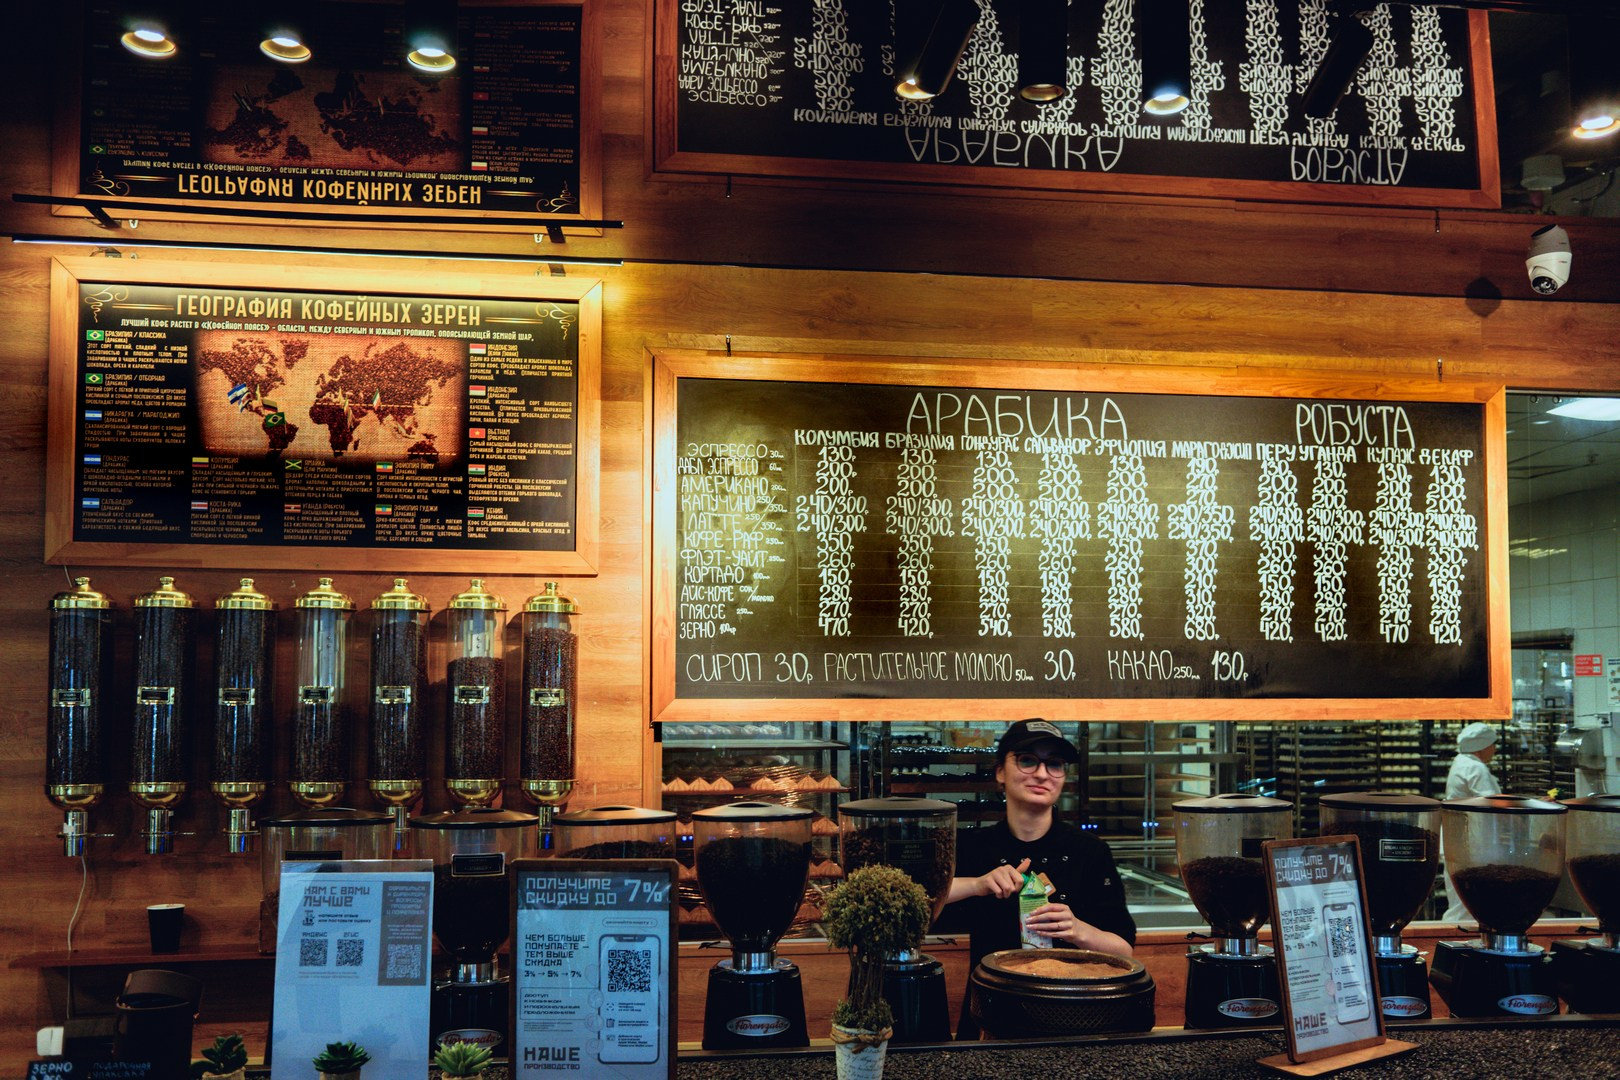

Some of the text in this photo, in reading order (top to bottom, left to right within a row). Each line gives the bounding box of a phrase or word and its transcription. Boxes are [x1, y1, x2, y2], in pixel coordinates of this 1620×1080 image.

[176, 294, 480, 326] ГЕОГРАФИЯ КОФЕЙНЫХ ЗЕРЕН
[121, 318, 149, 328] ЛУЧШИЙ
[151, 319, 169, 328] КОФЕ
[170, 320, 193, 329] РАСТЕТ
[194, 321, 199, 329] В
[309, 325, 332, 334] МЕЖДУ
[334, 326, 367, 335] СЕВЕРНЫМ
[376, 328, 401, 336] ЮЖНЫМ
[438, 330, 490, 340] ОПОЯСЫВАЮЩЕЙ
[492, 331, 516, 340] ЗЕМНОЙ
[906, 392, 1128, 440] АРАБИКА
[1296, 403, 1415, 449] РОБУСТА
[688, 443, 768, 458] ЭСПРЕССО
[795, 429, 879, 448] КОЛУМБИЯ
[886, 432, 954, 450] БРАЗИЛИЯ
[962, 435, 1019, 451] ГОНДУРАС
[1095, 438, 1166, 458] ЭФИОПИЯ
[1172, 442, 1252, 460] МАРАГОДЖИП
[1256, 442, 1296, 461] ПЕРУ
[1299, 444, 1357, 463] УГАНДА
[1368, 447, 1415, 464] КУПАЖ
[1418, 448, 1473, 466] ДЕКАФ
[678, 458, 703, 475] ДАБЛ
[708, 458, 759, 476] ЭСПРЕССО
[681, 476, 769, 495] АМЕРИКАНО
[682, 495, 756, 513] КАПУЧИНО
[688, 512, 742, 530] ЛАТТЕ
[684, 531, 764, 549] КОФЕ-РАФ
[680, 549, 769, 568] ФЛЭТ-УАЙТ
[684, 566, 745, 584] КОРТАДО
[680, 585, 734, 602] АЙС-КОФЕ
[680, 604, 726, 620] ГЛЯССЕ
[680, 621, 716, 639] ЗЕРНО
[1380, 624, 1409, 643] 470
[686, 653, 762, 682] СИРОП
[824, 652, 948, 682] РАСТИТЕЛЬНОЕ
[956, 652, 1013, 682] МОЛОКО
[1108, 650, 1173, 680] КАКАО
[1274, 854, 1323, 869] ПОЛУЧИТЕ
[1276, 854, 1352, 882] СКИДКУ ДО 7%
[304, 886, 370, 896] НАМ С ВАМИ
[526, 878, 663, 903] ПОЛУЧИТЕ 7%
[526, 892, 617, 906] СКИДКУ ДО
[304, 896, 354, 907] ЛУЧШЕ
[525, 959, 562, 967] СКИДКА
[1226, 1003, 1277, 1016] Fiorenzato
[734, 1018, 785, 1034] Fiorenzato
[1295, 1012, 1327, 1032] НАШЕ
[524, 1047, 580, 1062] НАШЕ
[32, 1062, 73, 1075] ЗЕРНО
